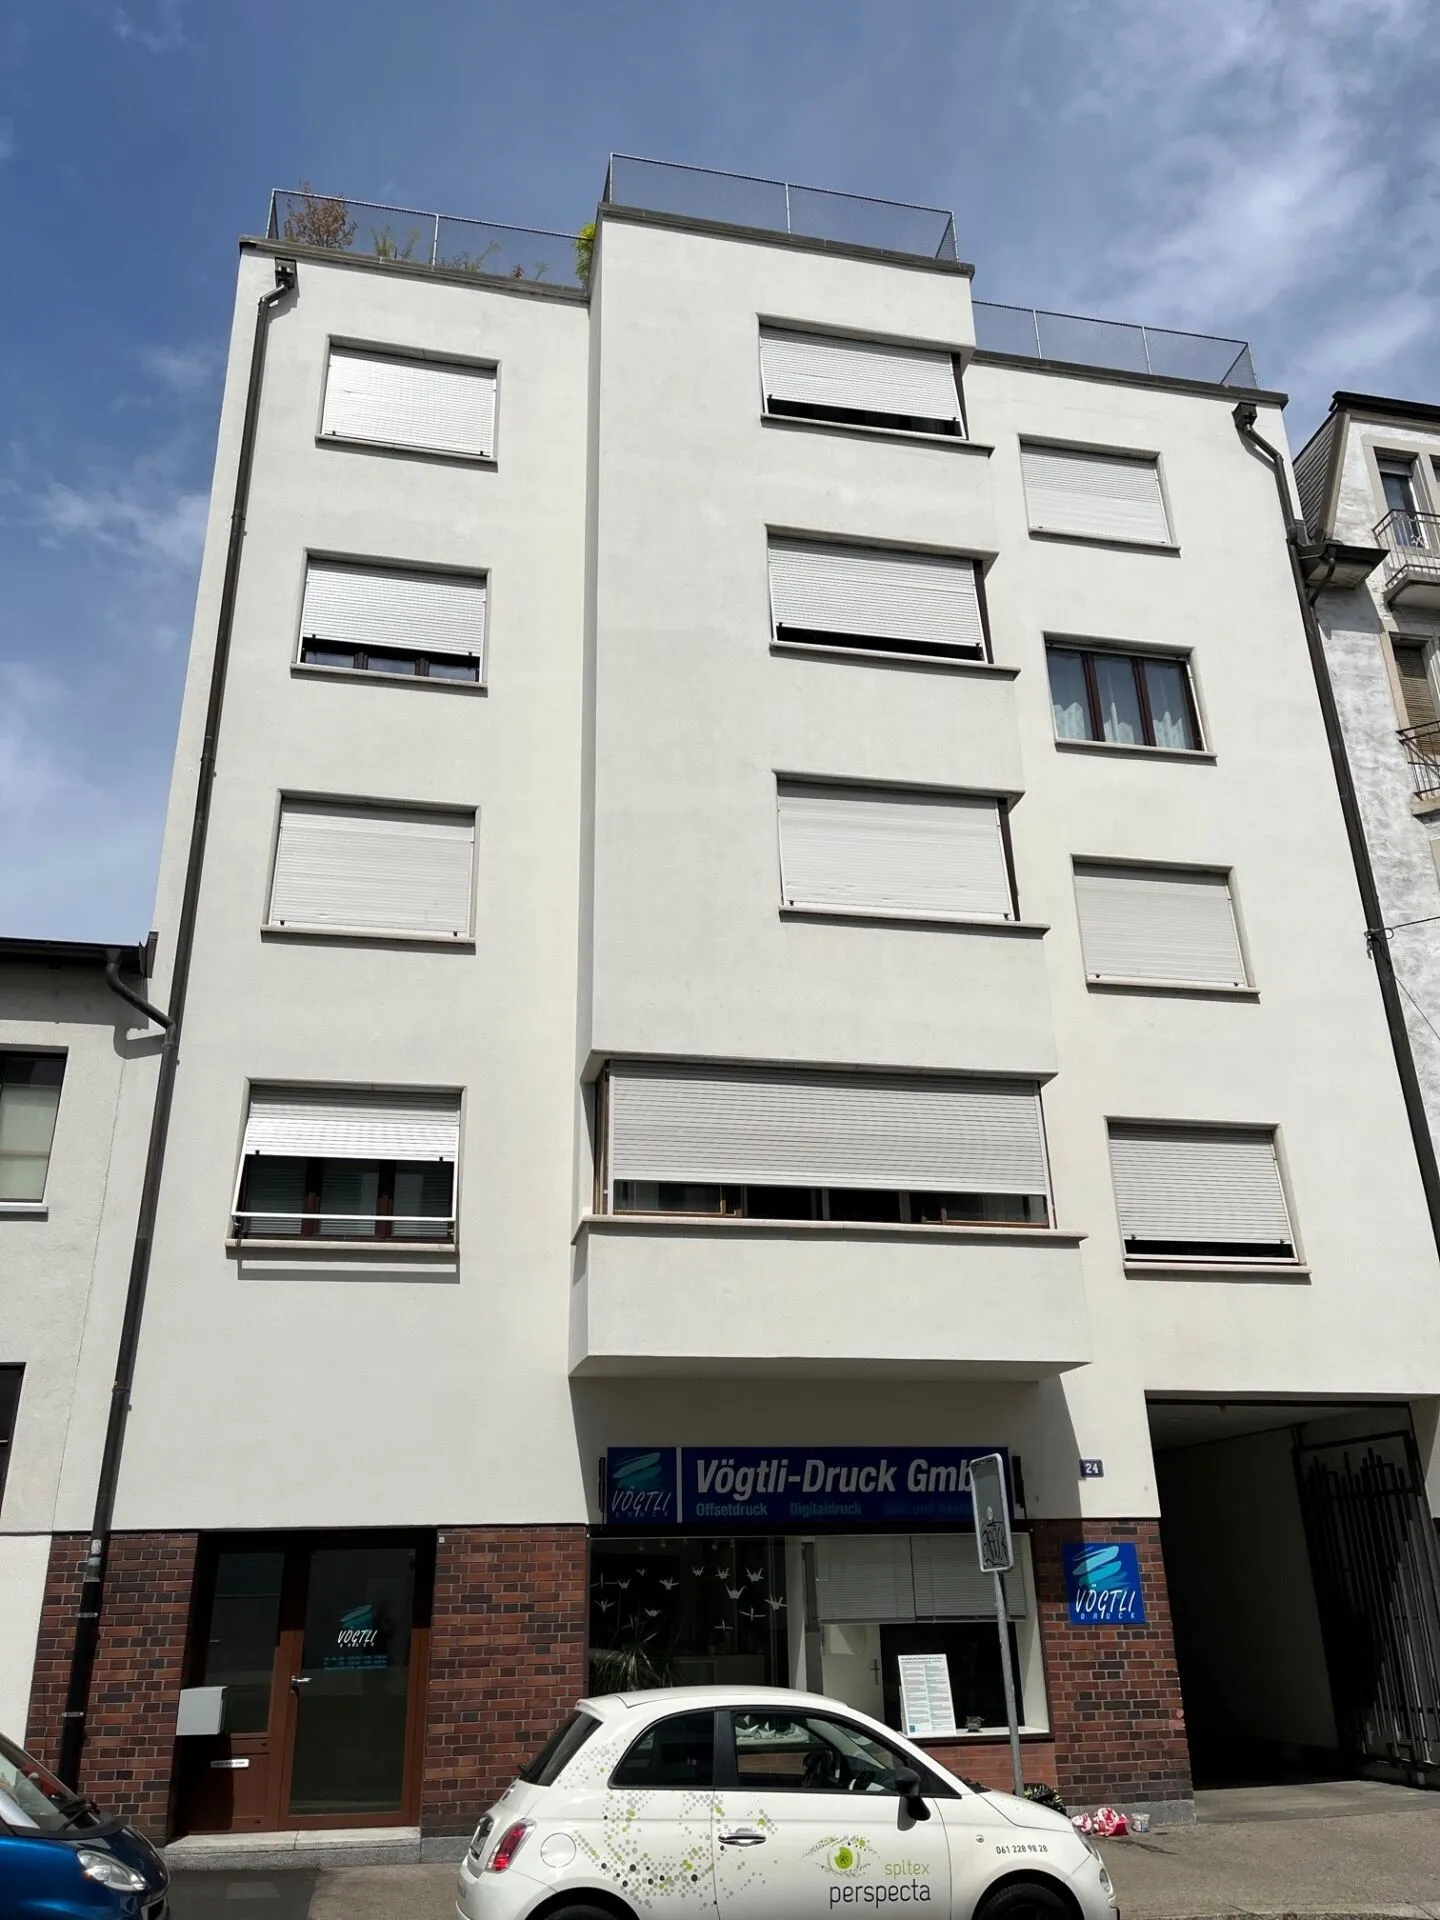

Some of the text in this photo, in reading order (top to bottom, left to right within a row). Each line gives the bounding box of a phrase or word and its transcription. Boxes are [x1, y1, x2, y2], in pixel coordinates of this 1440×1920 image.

[1085, 1463, 1099, 1474] 24
[697, 1458, 971, 1501] Vögtli-Druck Gmb
[611, 1485, 672, 1517] VÖGTLI
[696, 1502, 862, 1517] Offsetdruck Digitaldruck
[1075, 1583, 1136, 1619] VÖGTLI
[1080, 1612, 1135, 1620] DRUCK
[996, 1846, 1010, 1855] 061
[1012, 1845, 1027, 1853] 228
[1038, 1844, 1048, 1853] 28
[885, 1859, 930, 1879] spitex
[830, 1879, 931, 1909] perspecta
